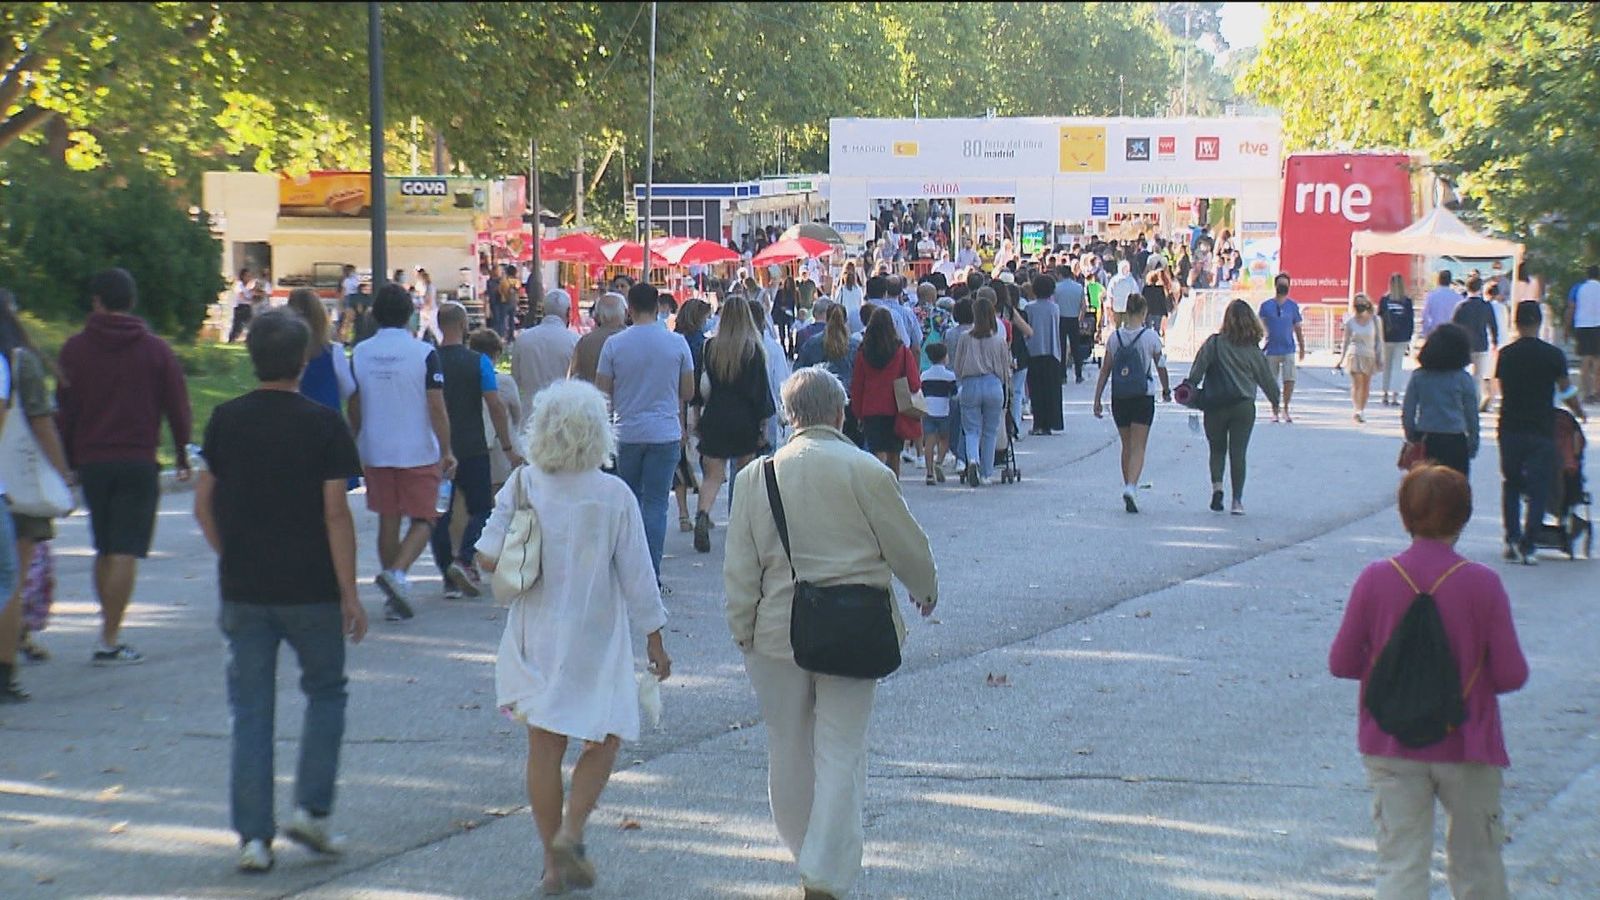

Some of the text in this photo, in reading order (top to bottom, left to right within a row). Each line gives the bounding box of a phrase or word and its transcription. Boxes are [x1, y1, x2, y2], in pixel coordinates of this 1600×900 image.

[962, 139, 982, 158] 80
[984, 150, 1015, 158] madrid
[1238, 140, 1269, 157] rtve
[402, 180, 447, 195] GOYA
[922, 183, 960, 195] SALIDA
[1140, 183, 1190, 194] ENTRADA
[1294, 181, 1373, 223] rne
